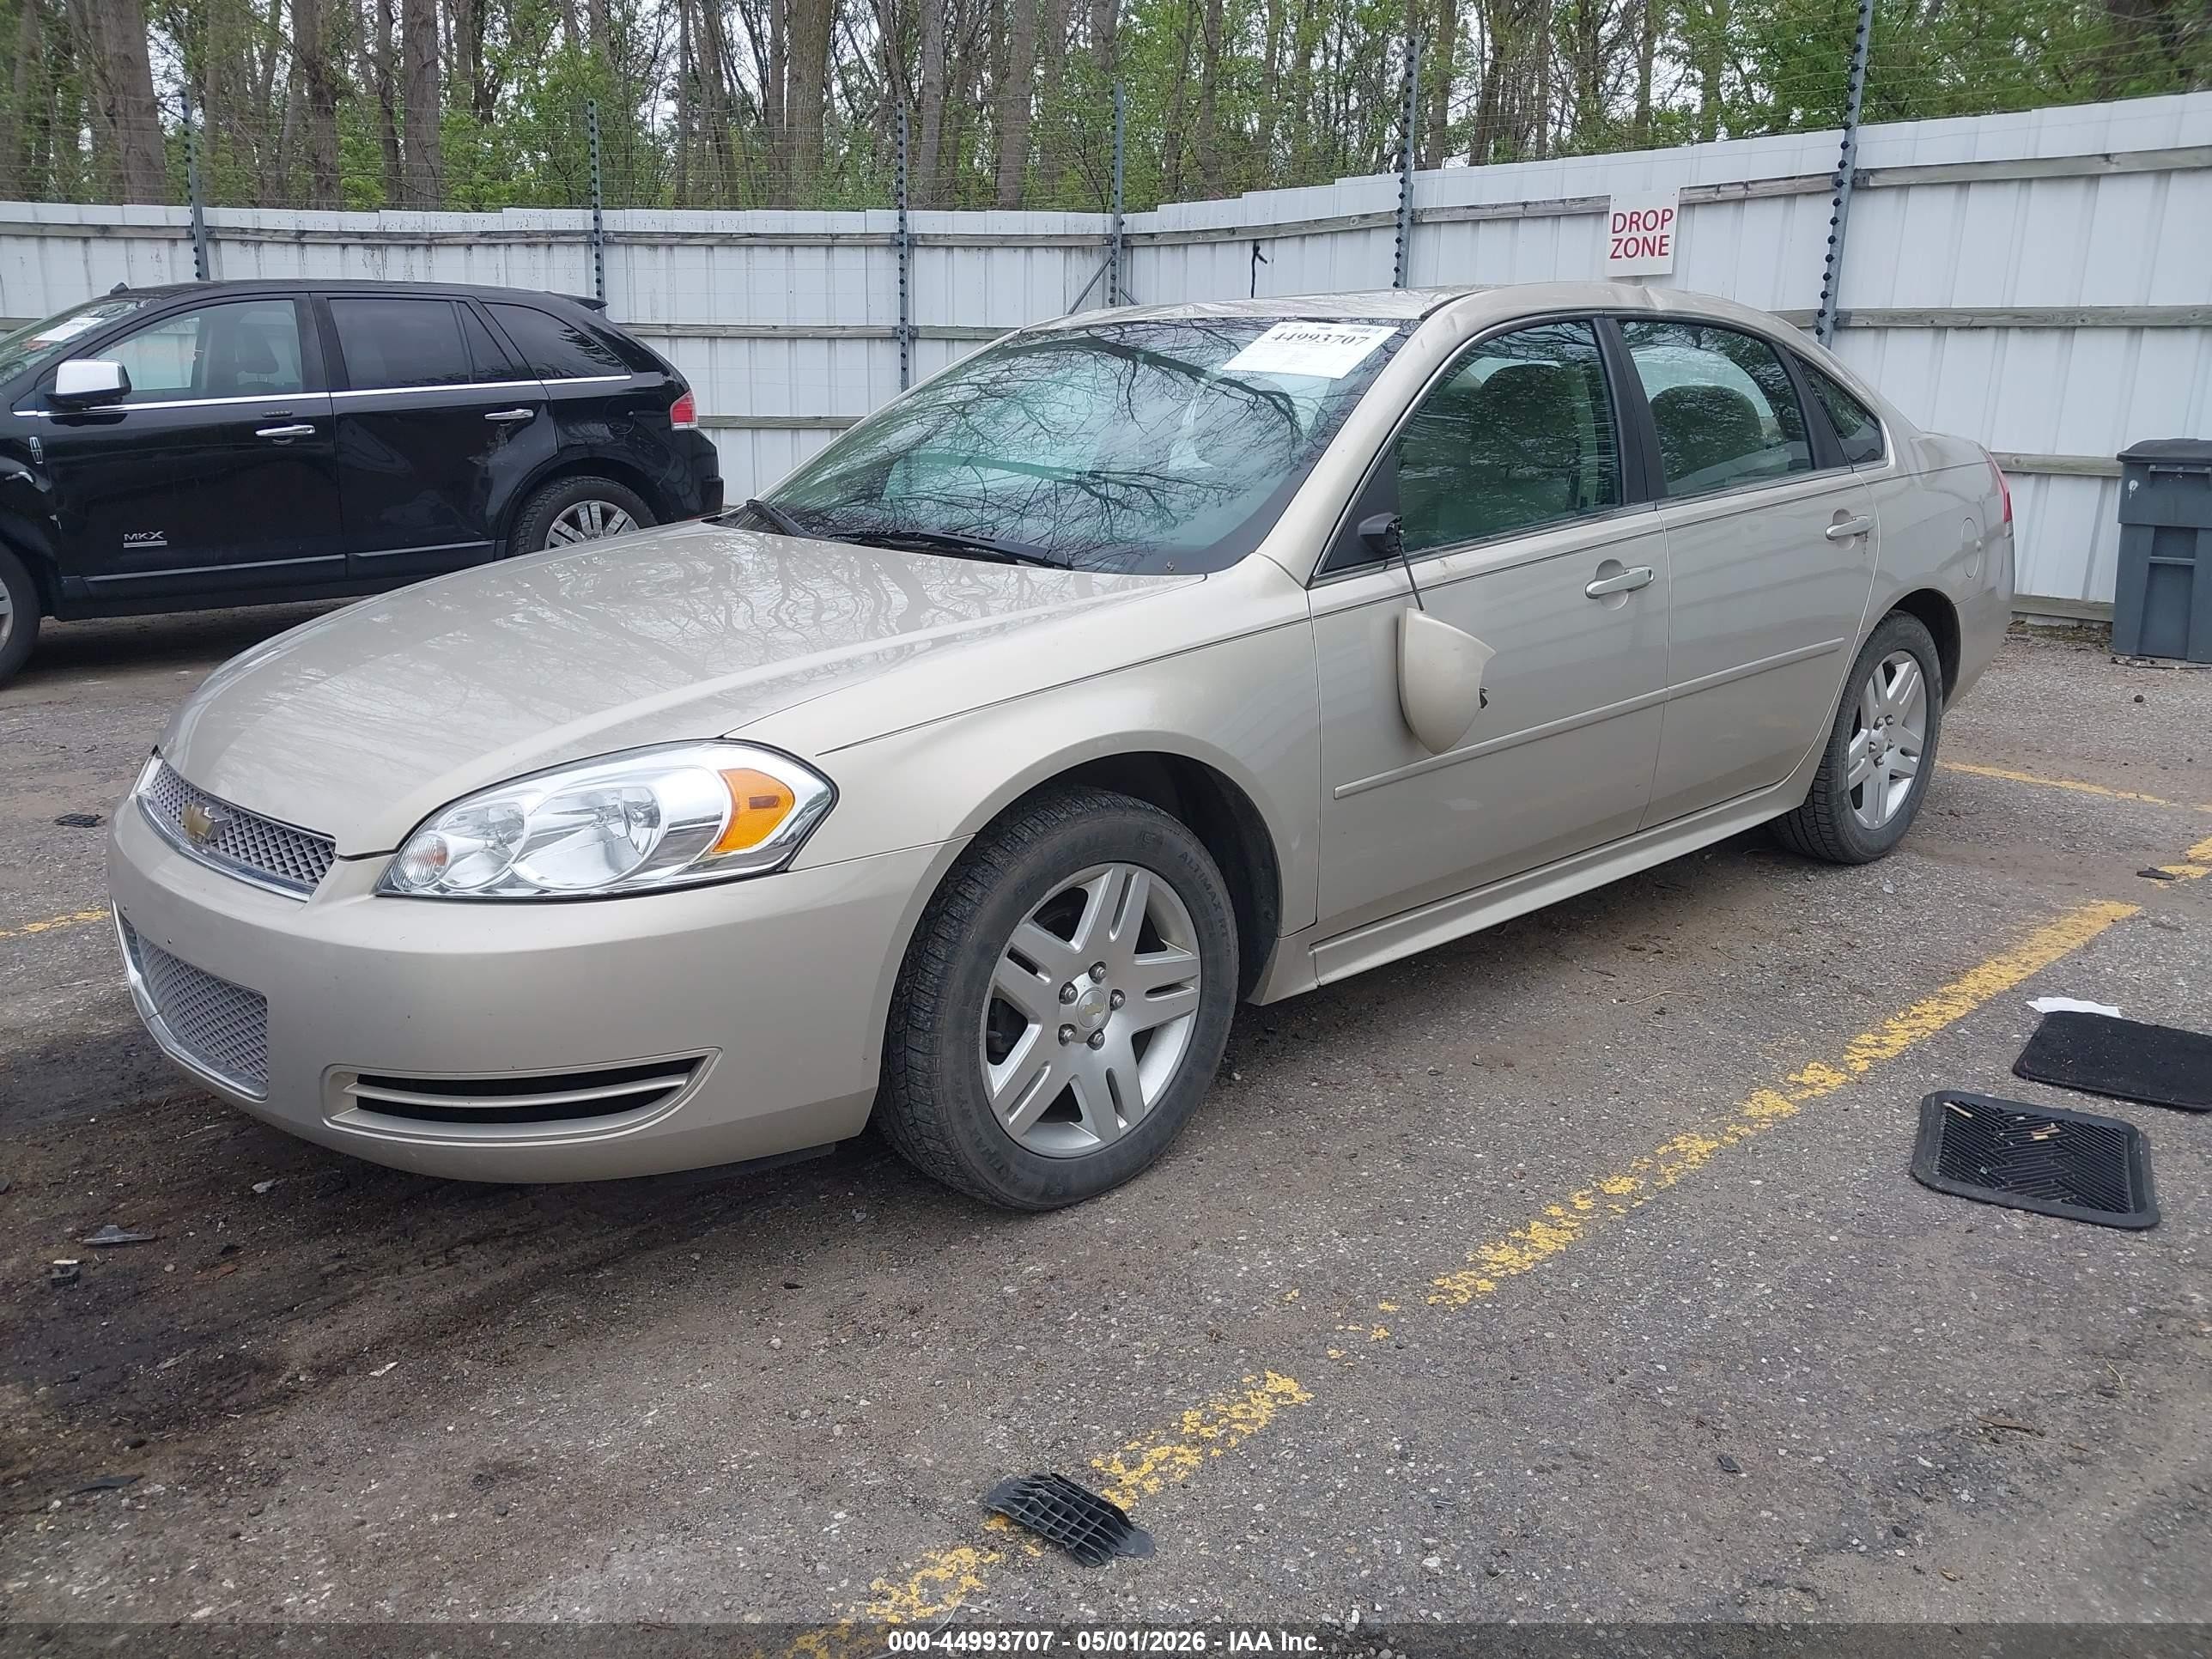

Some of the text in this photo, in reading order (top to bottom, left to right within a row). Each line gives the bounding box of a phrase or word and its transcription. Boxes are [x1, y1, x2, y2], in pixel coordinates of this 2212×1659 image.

[1612, 208, 1674, 234] DROP
[1609, 234, 1670, 259] ZONE
[1271, 331, 1370, 347] 44993707
[124, 531, 164, 541] MKX
